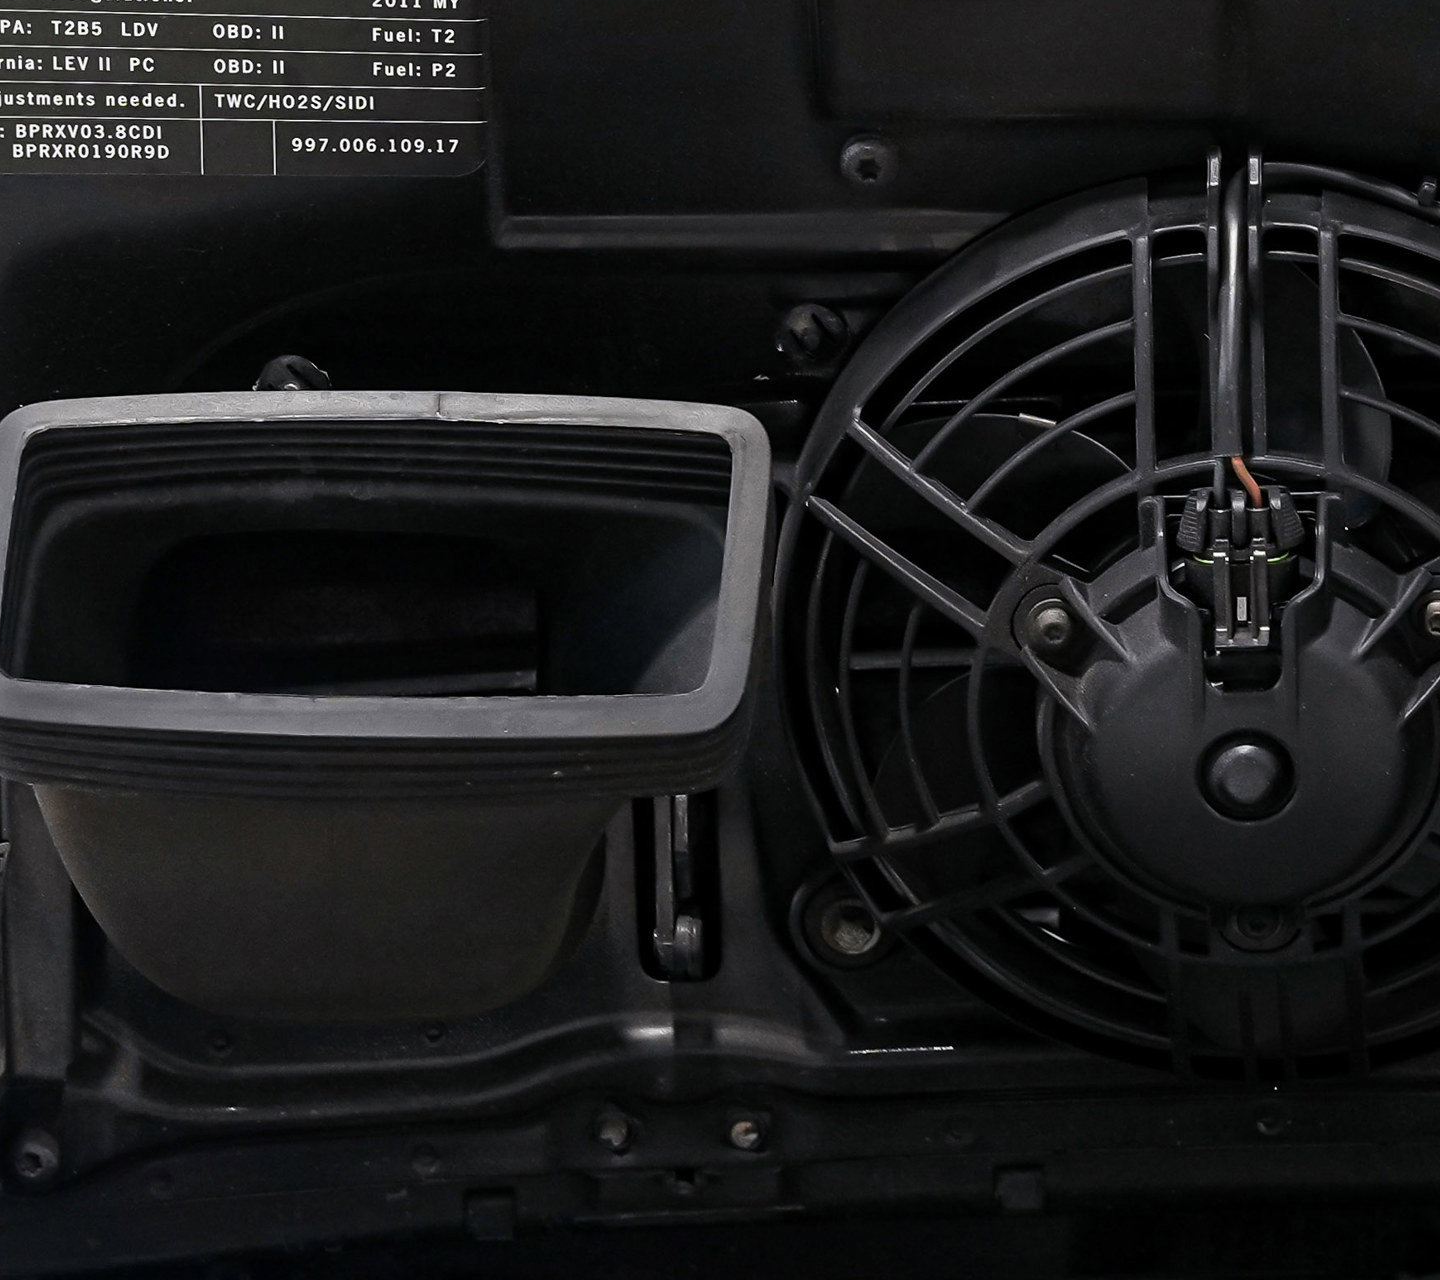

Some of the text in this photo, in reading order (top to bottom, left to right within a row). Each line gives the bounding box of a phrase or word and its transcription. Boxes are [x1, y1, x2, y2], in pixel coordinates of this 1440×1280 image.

[51, 21, 101, 35] T2B5
[122, 22, 158, 36] LDV
[213, 24, 260, 39] OBD:
[373, 28, 454, 43] Fuel: T2
[53, 56, 88, 70] LEV
[130, 58, 154, 72] PC
[214, 59, 261, 73] OBD:
[374, 62, 455, 77] Fuel: P2
[106, 93, 184, 107] needed.
[215, 94, 373, 111] TWC/HO2S/SIDI
[16, 124, 161, 139] BPRXV03.8CDI
[292, 138, 458, 152] 997.006.109.17
